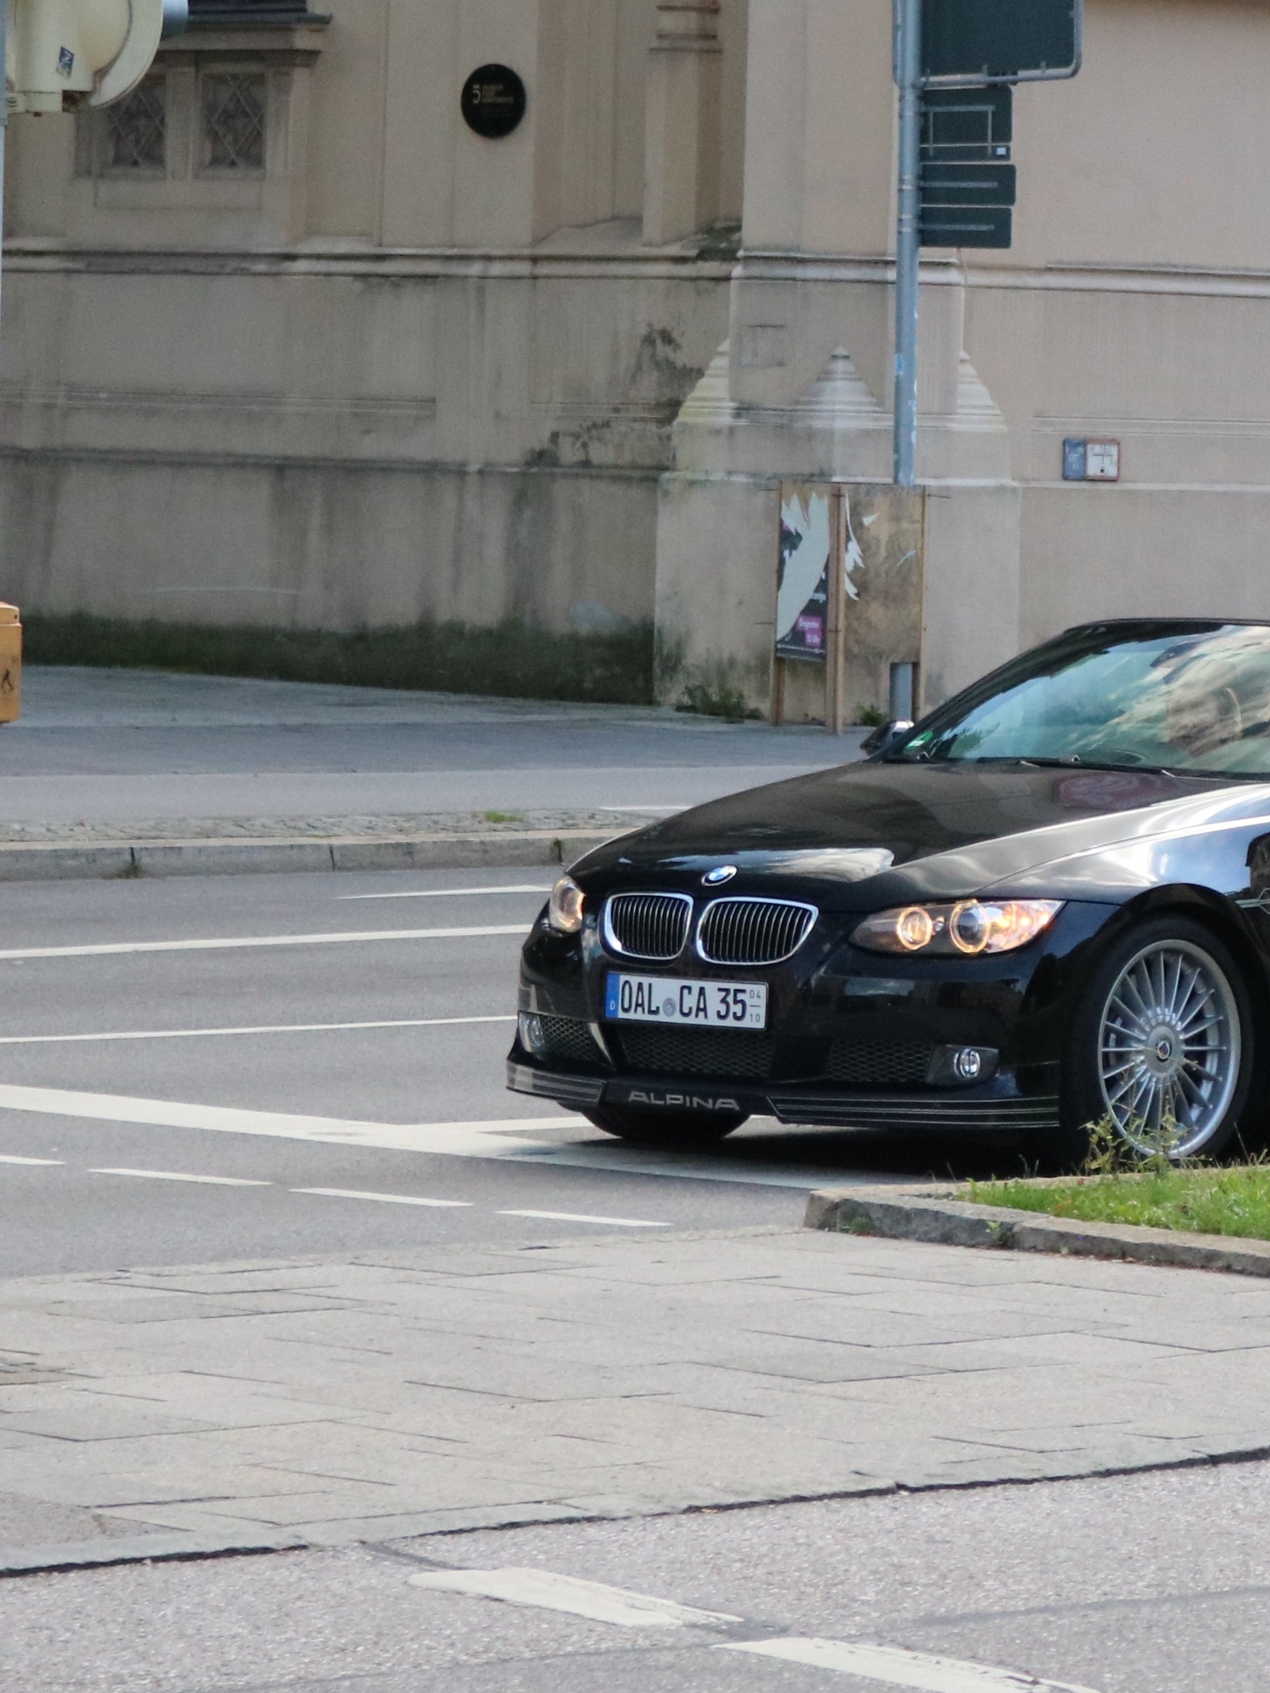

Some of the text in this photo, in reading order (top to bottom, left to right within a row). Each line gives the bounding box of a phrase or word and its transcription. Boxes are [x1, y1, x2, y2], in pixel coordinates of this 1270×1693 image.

[749, 989, 761, 999] 04
[620, 980, 747, 1021] OAL CA 35
[609, 1002, 616, 1011] D
[750, 1013, 761, 1023] 10
[628, 1091, 740, 1111] ALPINA
